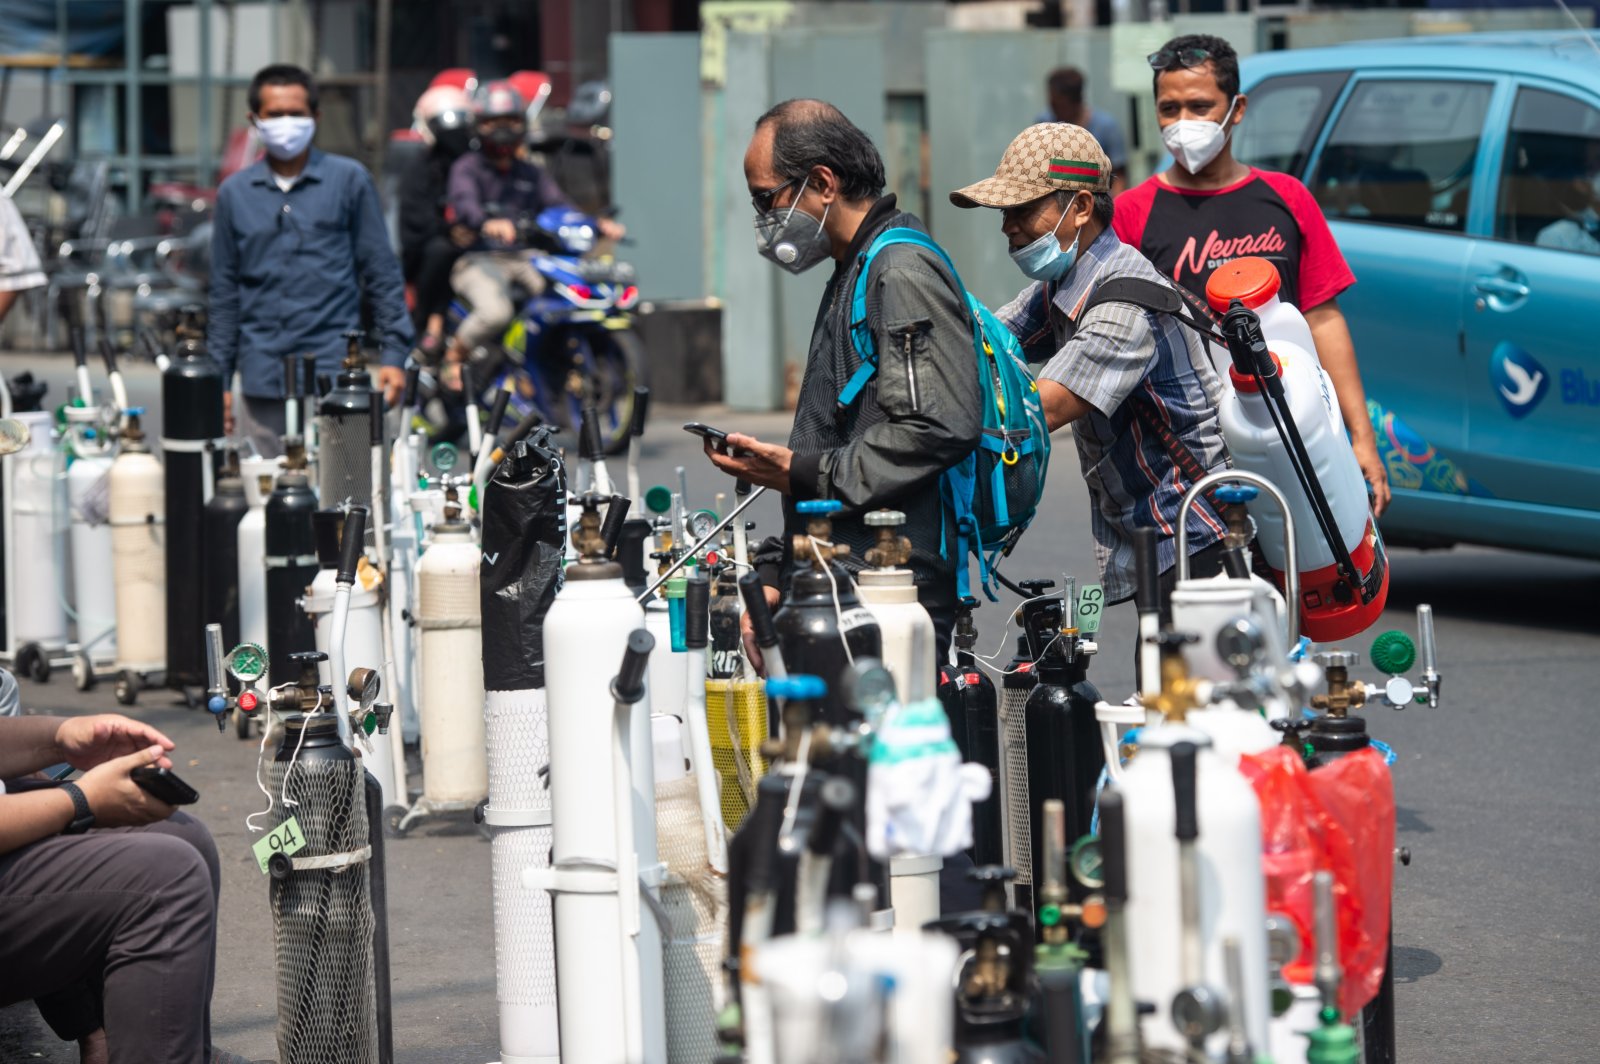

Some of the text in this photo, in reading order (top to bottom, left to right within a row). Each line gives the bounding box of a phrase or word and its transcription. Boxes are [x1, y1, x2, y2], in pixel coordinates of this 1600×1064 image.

[1173, 226, 1287, 281] Nevada
[1080, 588, 1102, 615] 95
[269, 824, 297, 852] 94
